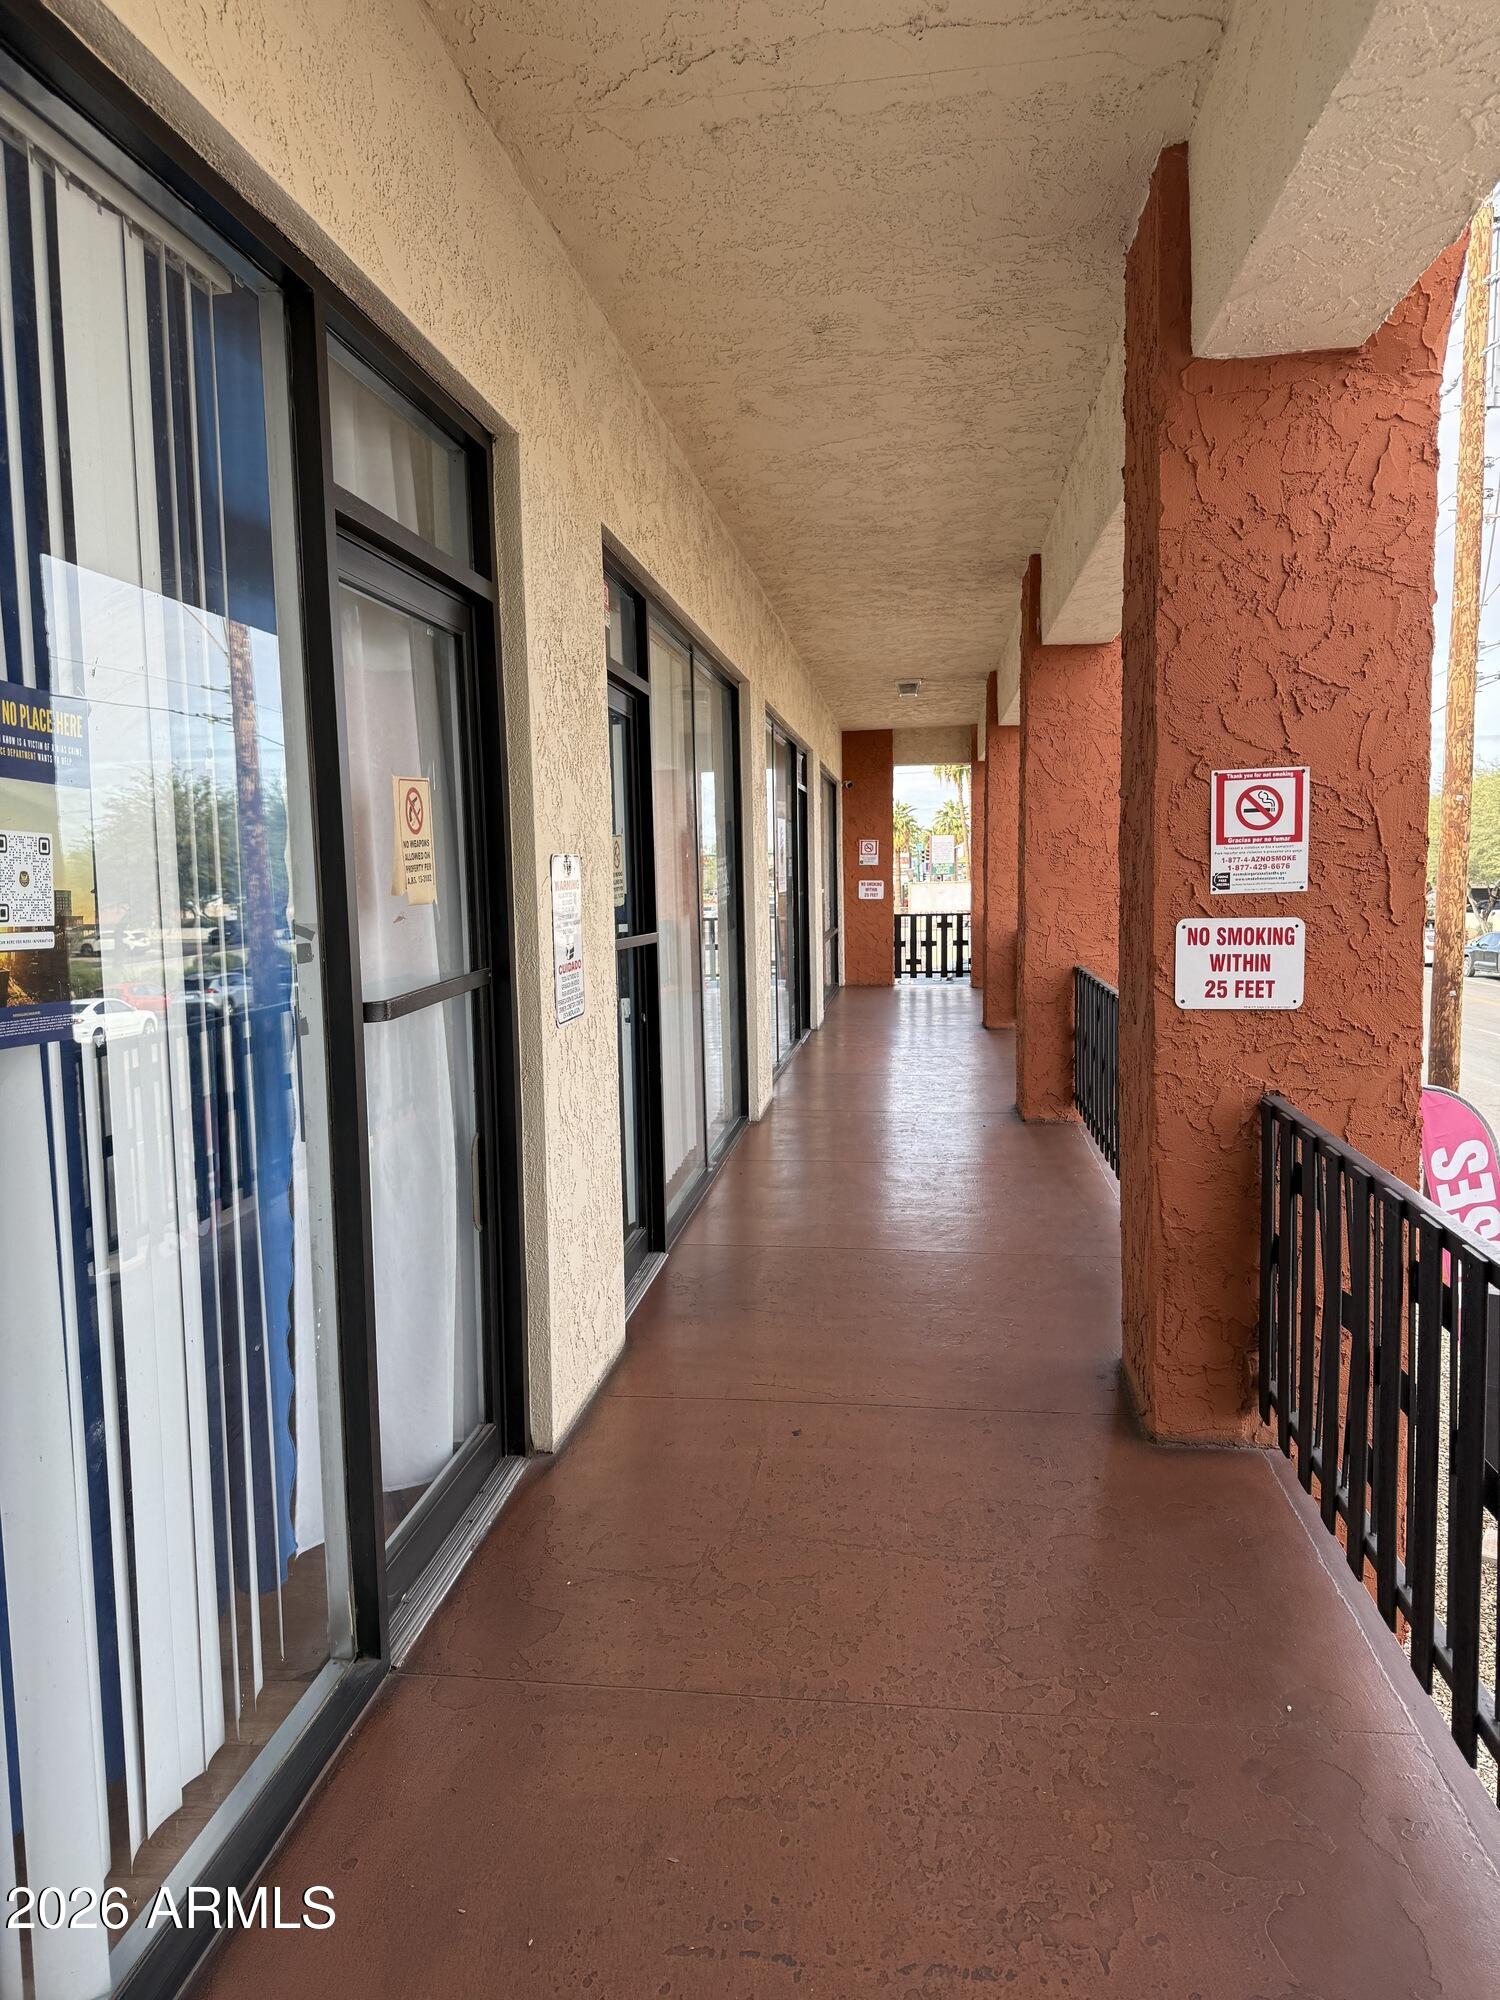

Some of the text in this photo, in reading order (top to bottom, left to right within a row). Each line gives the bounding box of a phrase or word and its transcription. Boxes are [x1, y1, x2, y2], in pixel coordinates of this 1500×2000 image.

[2, 699, 83, 738] NO PLACE HERE
[2, 734, 15, 746] KNOW
[27, 739, 43, 751] VICTIM
[7, 748, 36, 760] DEPARTMENT
[37, 753, 53, 763] WANTS
[1222, 855, 1297, 863] 1-877-4-AZNOSMOKE
[1228, 863, 1291, 871] 1-877-429-6676
[1187, 927, 1295, 946] NO SMOKING
[558, 959, 582, 975] CUIDADO
[1209, 953, 1271, 972] WITHIN
[1204, 980, 1276, 998] 25 FEET
